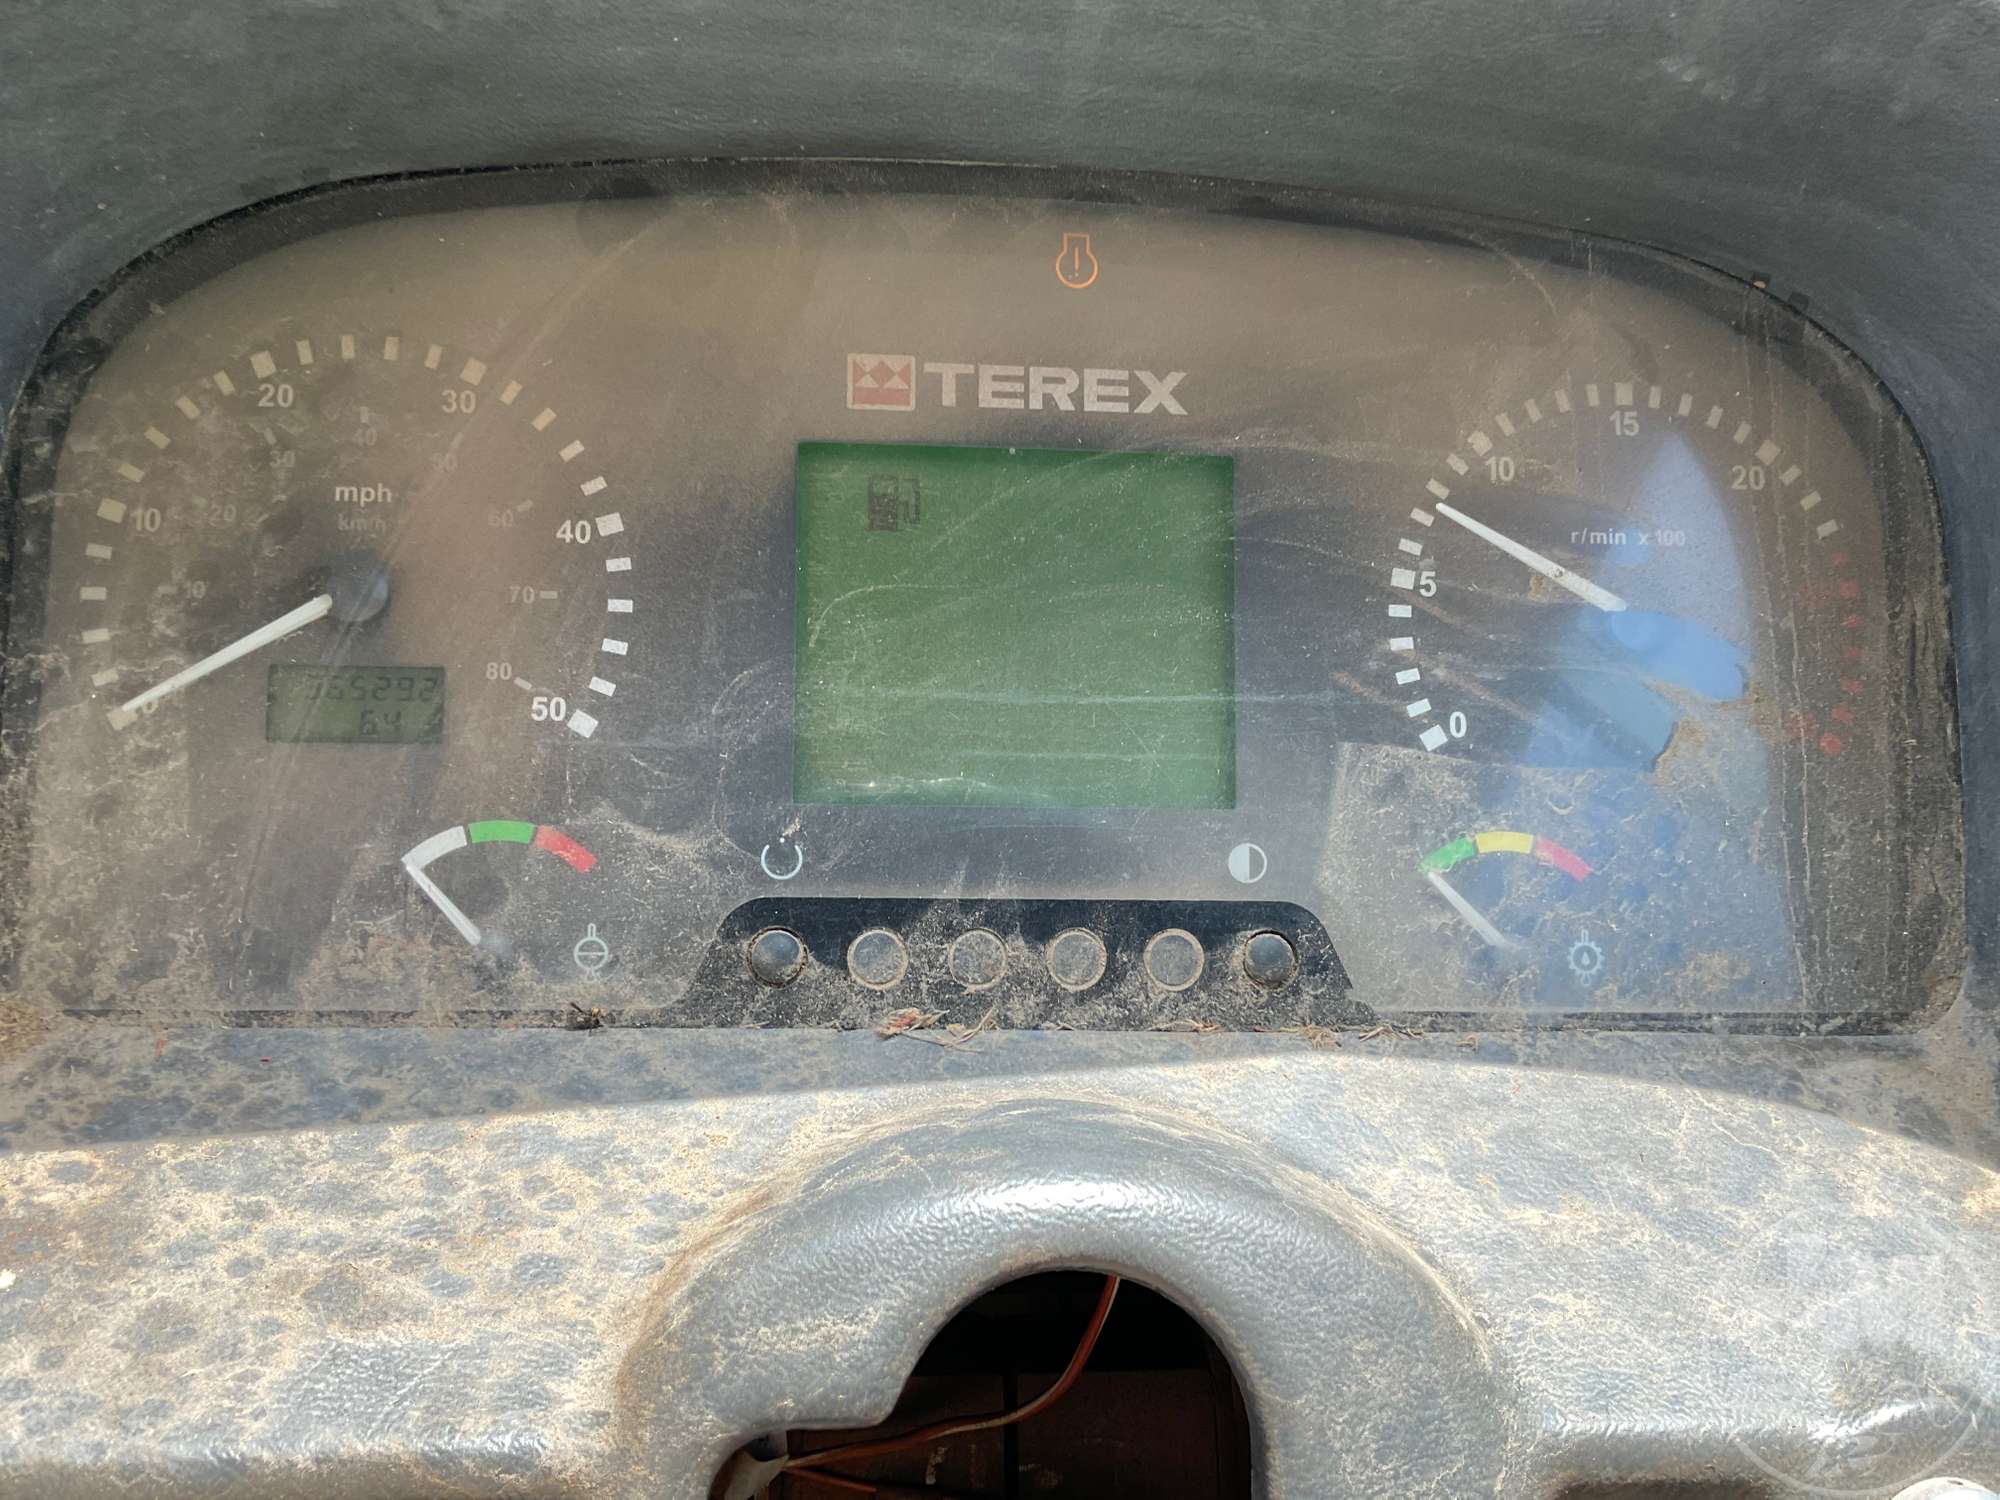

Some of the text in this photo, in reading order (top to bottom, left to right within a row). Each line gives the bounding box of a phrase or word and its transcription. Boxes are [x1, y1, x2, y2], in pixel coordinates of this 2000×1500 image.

[257, 383, 294, 408] 20
[923, 362, 1188, 415] TEREX
[440, 389, 476, 414] 30
[1609, 411, 1640, 436] 15
[1485, 456, 1515, 482] 10
[1731, 465, 1765, 490] 20
[335, 483, 392, 507] mph
[130, 506, 161, 533] 10
[556, 518, 592, 545] 40
[1570, 527, 1686, 547] r/min x 100
[509, 586, 535, 604] 70
[1419, 570, 1437, 598] 5
[486, 662, 512, 681] 80
[530, 696, 567, 722] 50
[1449, 711, 1467, 738] 0
